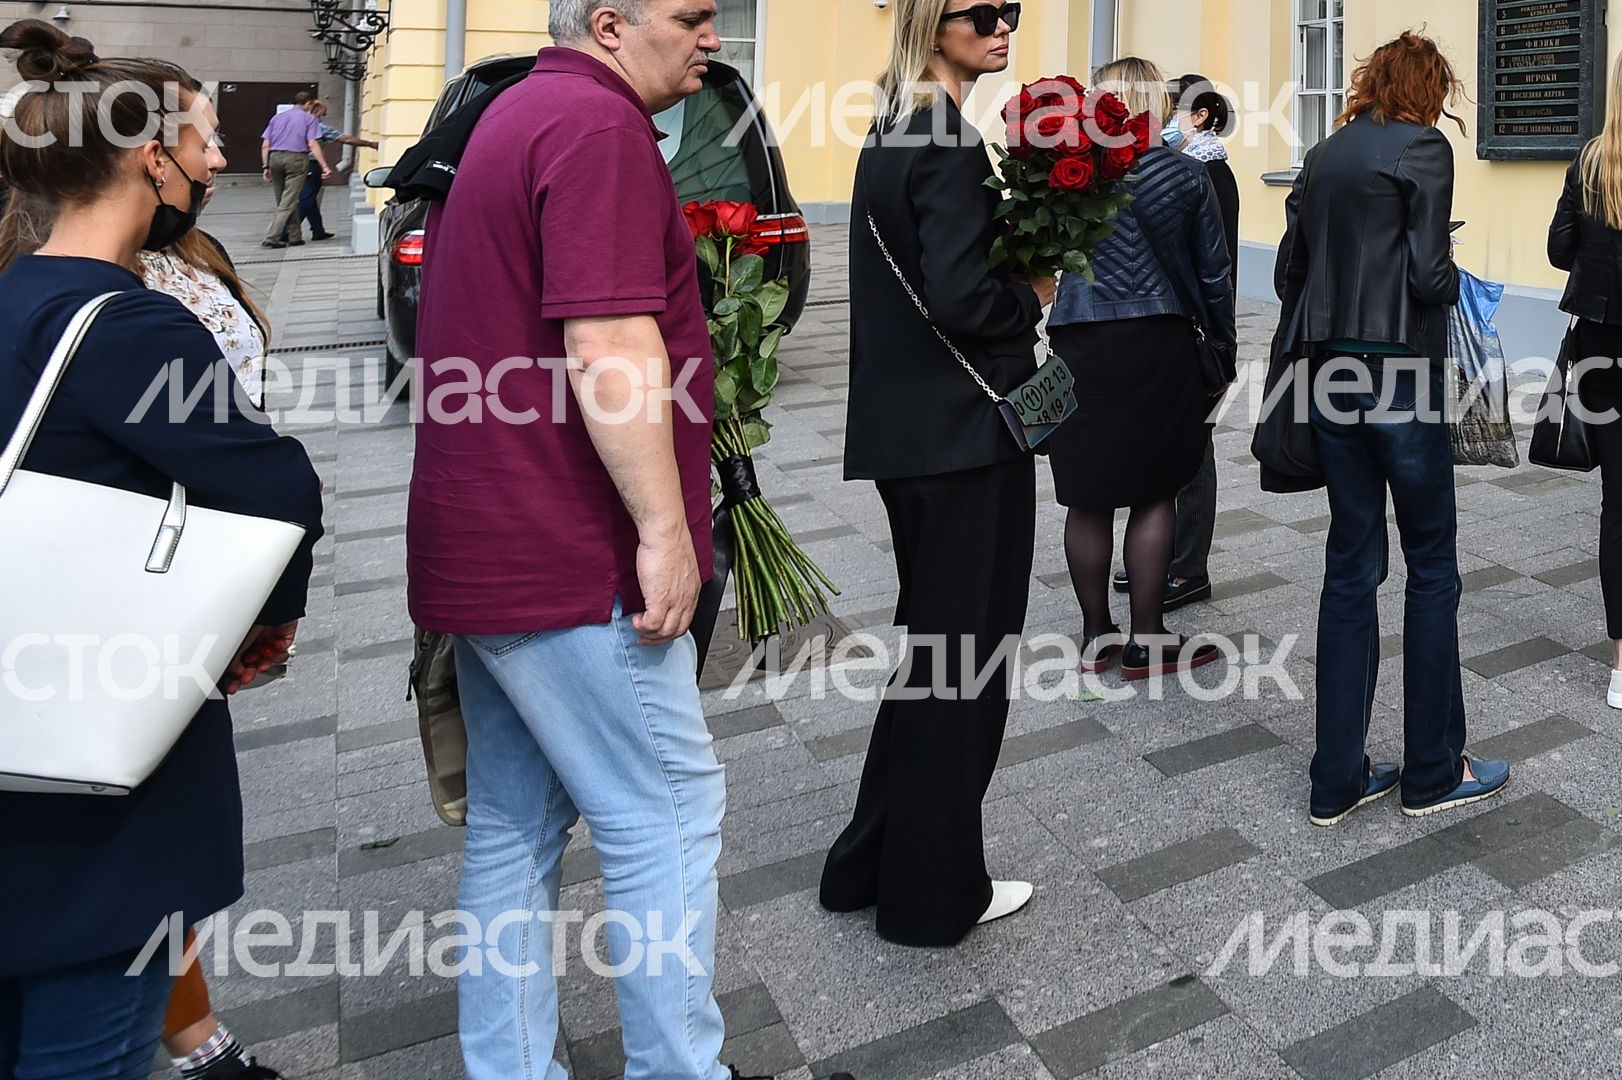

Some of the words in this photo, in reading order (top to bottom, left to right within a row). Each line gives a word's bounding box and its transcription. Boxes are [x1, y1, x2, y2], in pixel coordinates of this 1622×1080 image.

[1525, 38, 1560, 48] ФИЗИКИ
[1525, 73, 1557, 83] ИГРОКИ
[1014, 401, 1026, 417] 0
[1025, 387, 1041, 407] 11
[1039, 376, 1055, 395] 12
[1053, 365, 1066, 383] 13
